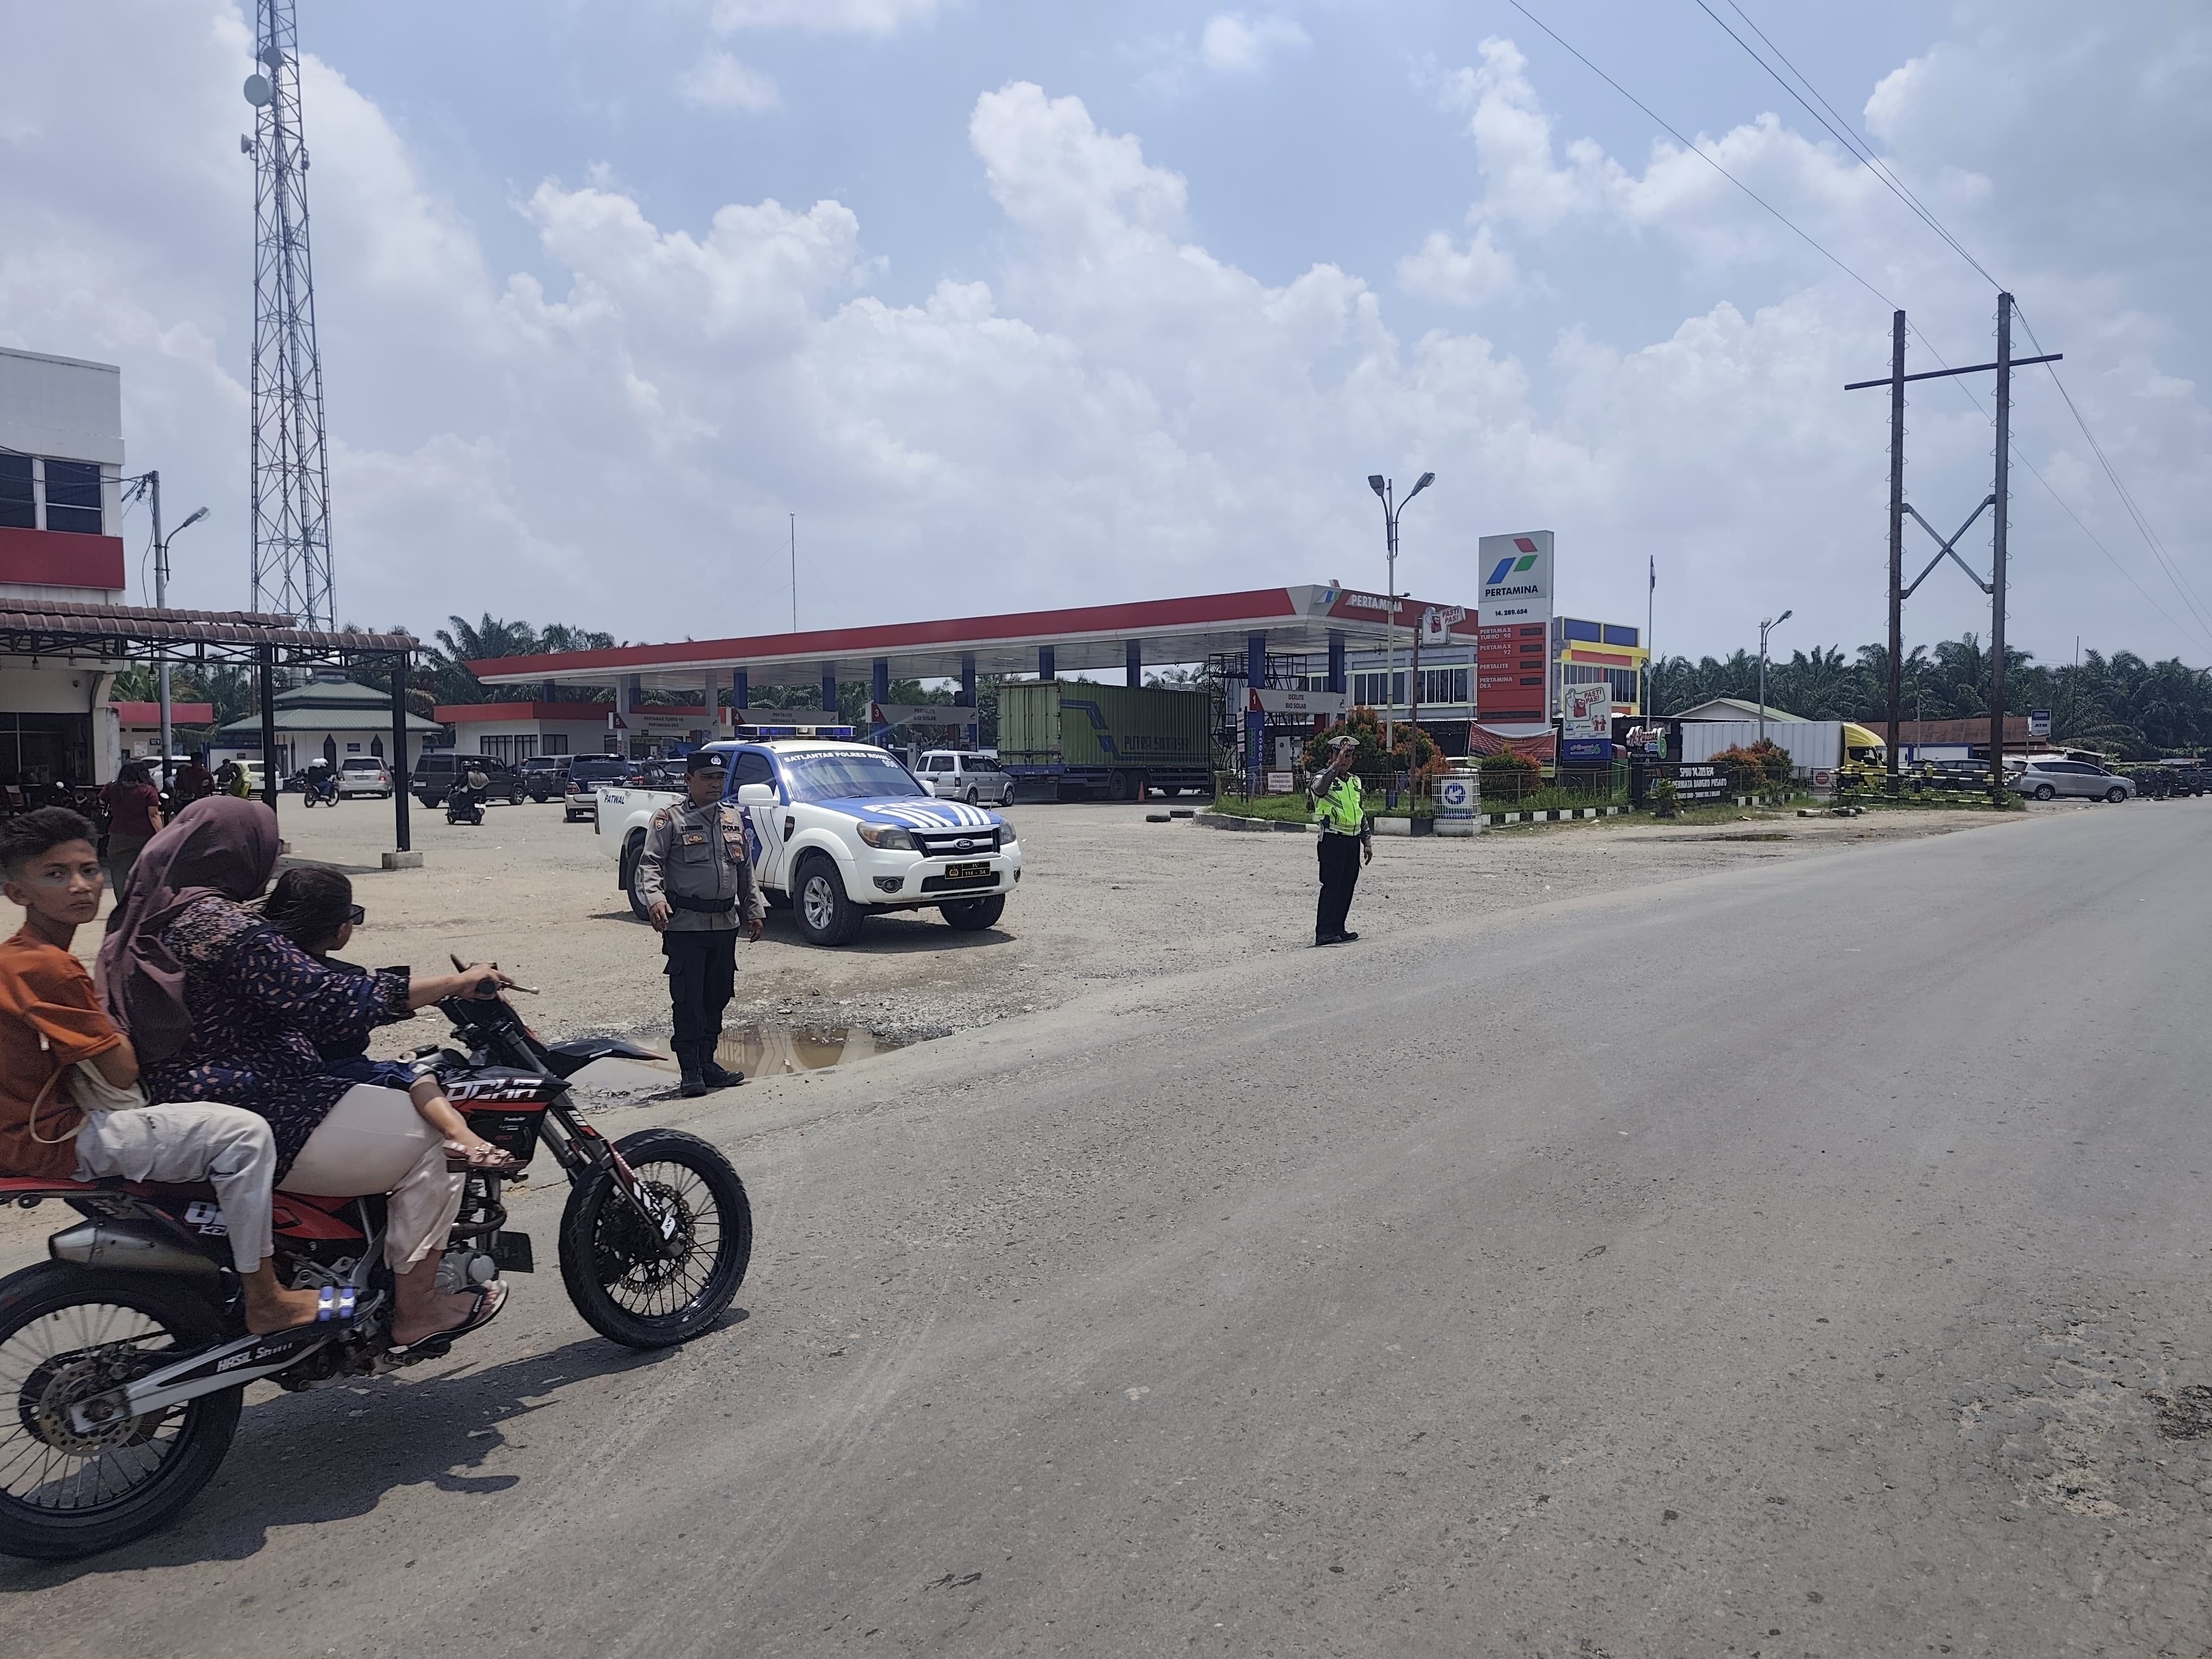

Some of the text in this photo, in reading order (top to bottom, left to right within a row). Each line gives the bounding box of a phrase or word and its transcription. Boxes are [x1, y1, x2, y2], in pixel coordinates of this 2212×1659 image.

[1485, 585, 1538, 597] PERTAMINA
[1442, 607, 1459, 618] PASTI
[1445, 615, 1458, 624] PAS!
[1584, 689, 1602, 699] PASTI
[1252, 695, 1256, 704] 1
[1586, 695, 1600, 704] PAS!
[874, 709, 879, 717] 3
[1657, 727, 1667, 759] 6
[783, 752, 834, 762] SATLANTAS
[867, 753, 891, 761] ROHIL
[604, 795, 625, 805] PATWAL
[862, 801, 962, 813] POLI
